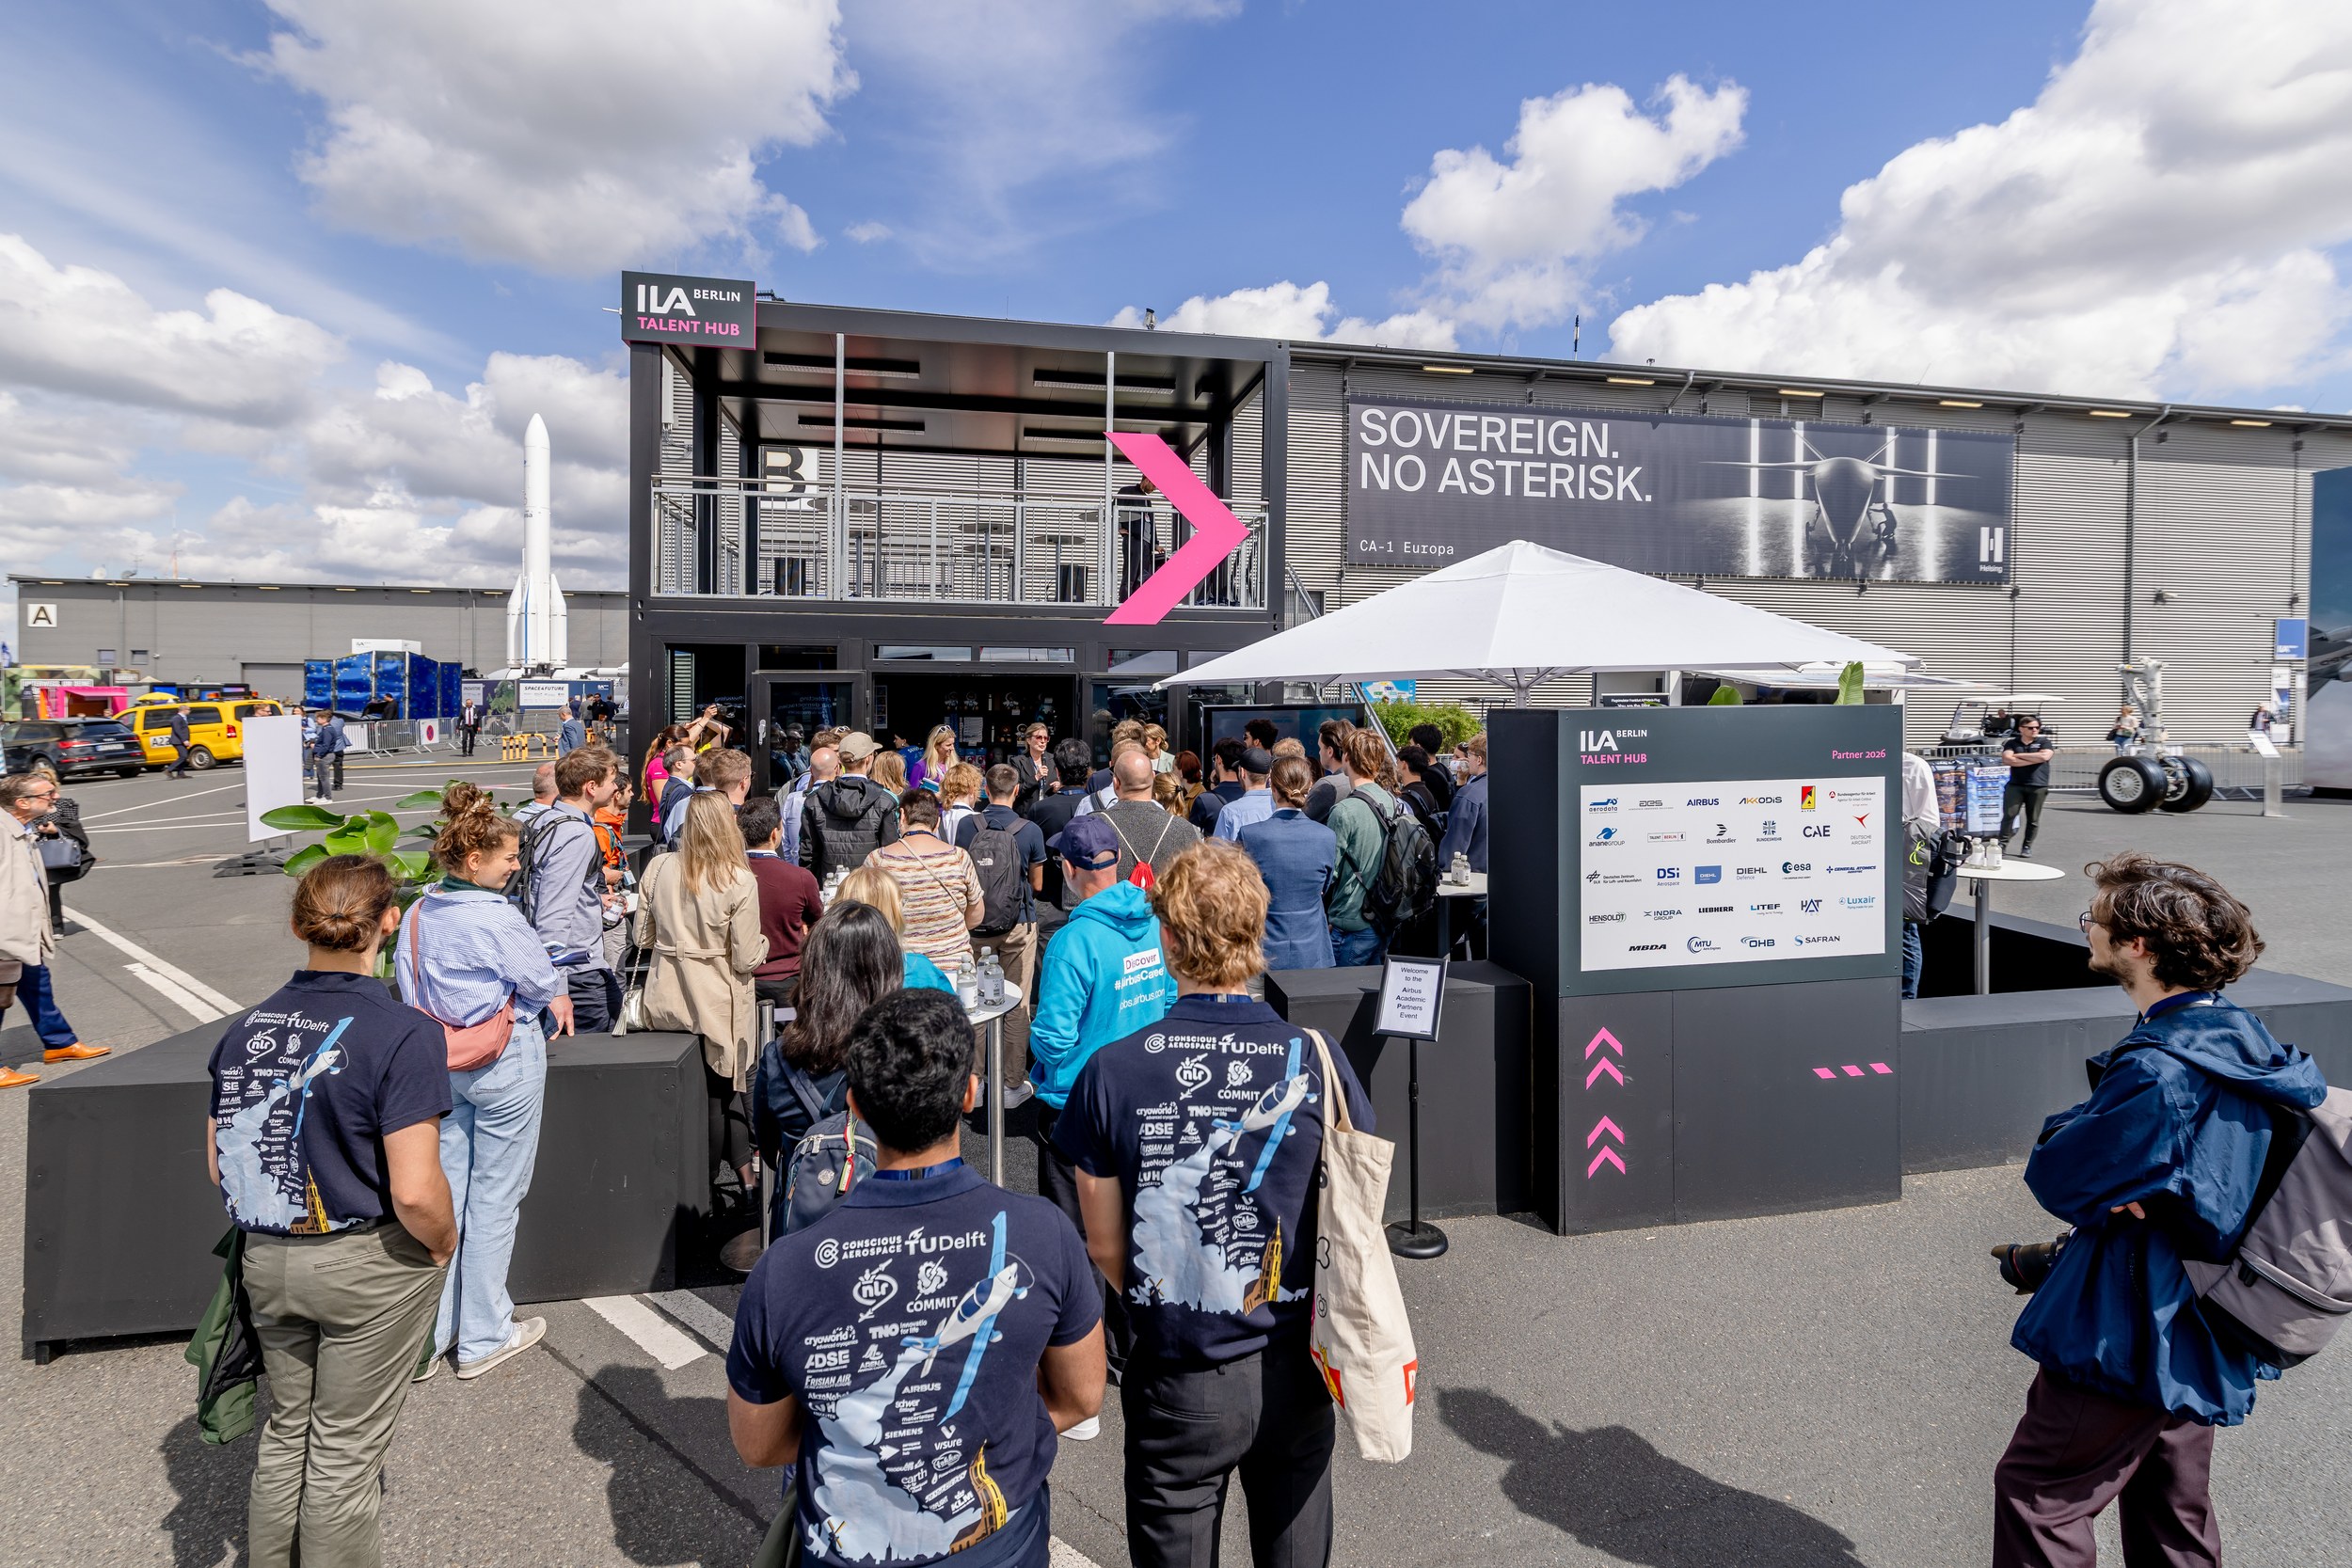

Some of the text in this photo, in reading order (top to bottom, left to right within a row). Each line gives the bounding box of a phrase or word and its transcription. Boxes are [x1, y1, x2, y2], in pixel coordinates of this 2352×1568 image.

[637, 284, 741, 316] ILA BERLIN
[637, 317, 740, 337] TALENT HUB
[1359, 408, 1619, 459] SOVEREIGN.
[758, 446, 806, 502] B
[1360, 452, 1652, 502] NO ASTERISK.
[1359, 539, 1454, 556] CA-1 Europa
[1979, 564, 2004, 574] Helsing
[33, 606, 53, 626] A
[1580, 729, 1647, 752] ILA BERLIN
[1581, 753, 1647, 765] TALENT HUB
[1832, 749, 1886, 760] Partner 2026
[1687, 798, 1720, 807] AIRBUS
[1803, 826, 1831, 837] CAE
[1793, 863, 1812, 872] esa
[1847, 895, 1876, 905] Luxair
[1750, 903, 1781, 911] LITEF
[1588, 913, 1625, 923] HENSOLDT
[1694, 940, 1712, 948] MTU
[1749, 939, 1775, 948] OHB
[1804, 935, 1840, 943] SAFRAN
[1629, 943, 1667, 952] MBDA
[1125, 953, 1157, 971] Discover
[251, 1040, 271, 1051] nlr
[1168, 1041, 1217, 1051] AEROSPACE
[278, 1056, 301, 1067] COMMIT
[1183, 1069, 1204, 1082] nlr
[1217, 1089, 1261, 1101] COMMIT
[1136, 1104, 1172, 1117] cryoworld
[1187, 1105, 1212, 1117] TNO
[1201, 1192, 1228, 1204] SIEMENS
[842, 1235, 902, 1251] CONSCIOUS
[842, 1244, 902, 1260] AEROSPACE
[861, 1280, 888, 1299] nlr
[906, 1295, 958, 1313] COMMIT
[868, 1323, 899, 1339] TNO
[804, 1332, 849, 1347] cryoworld
[805, 1373, 851, 1386] FRISIAN AIR
[901, 1383, 942, 1395] AIRBUS
[884, 1427, 923, 1440] SIEMENS
[900, 1468, 928, 1484] earth
[950, 1490, 974, 1512] KLM
